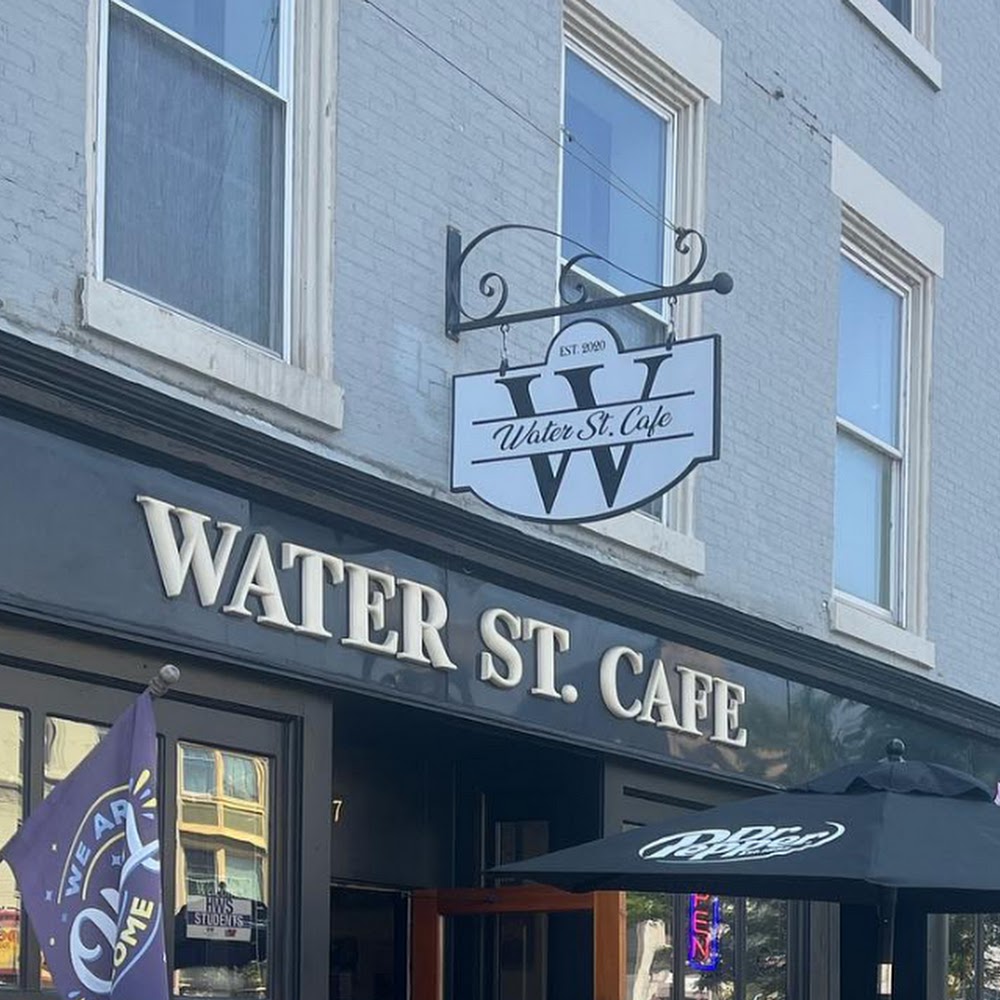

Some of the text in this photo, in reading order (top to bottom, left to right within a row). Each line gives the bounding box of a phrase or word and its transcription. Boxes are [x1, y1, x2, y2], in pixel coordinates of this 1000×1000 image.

[559, 339, 606, 357] EST. 2020
[492, 405, 673, 451] Water St. Cafe
[136, 495, 747, 748] WATER ST. CAFE
[65, 799, 130, 897] WE AR
[194, 912, 244, 927] STUDENTS
[206, 896, 234, 915] HWS
